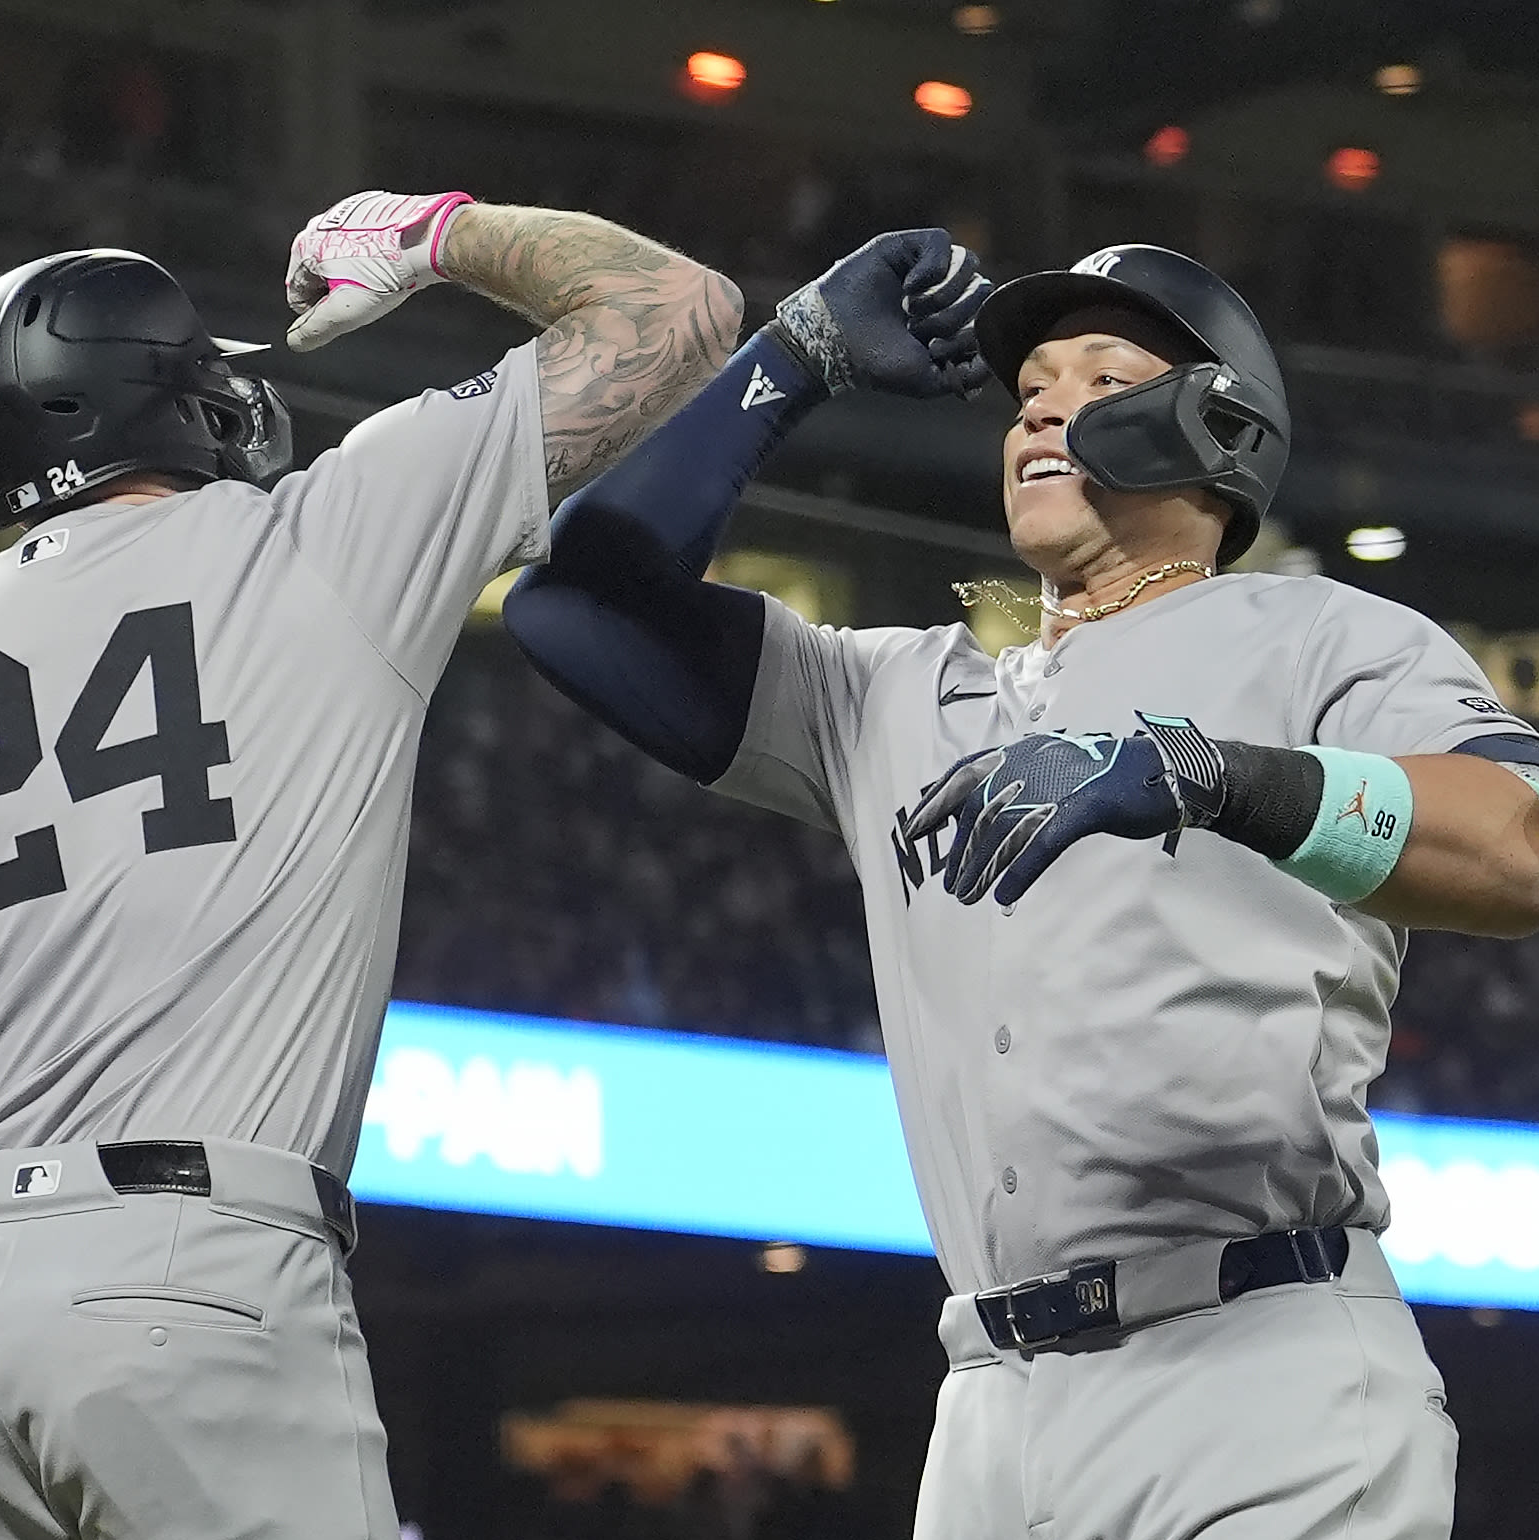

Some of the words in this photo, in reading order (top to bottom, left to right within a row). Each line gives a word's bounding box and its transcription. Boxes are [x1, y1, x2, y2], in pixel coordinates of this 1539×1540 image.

[46, 459, 86, 496] 24
[1371, 810, 1397, 841] 99
[363, 1045, 604, 1180] -PAIN
[1075, 1278, 1109, 1315] 99
